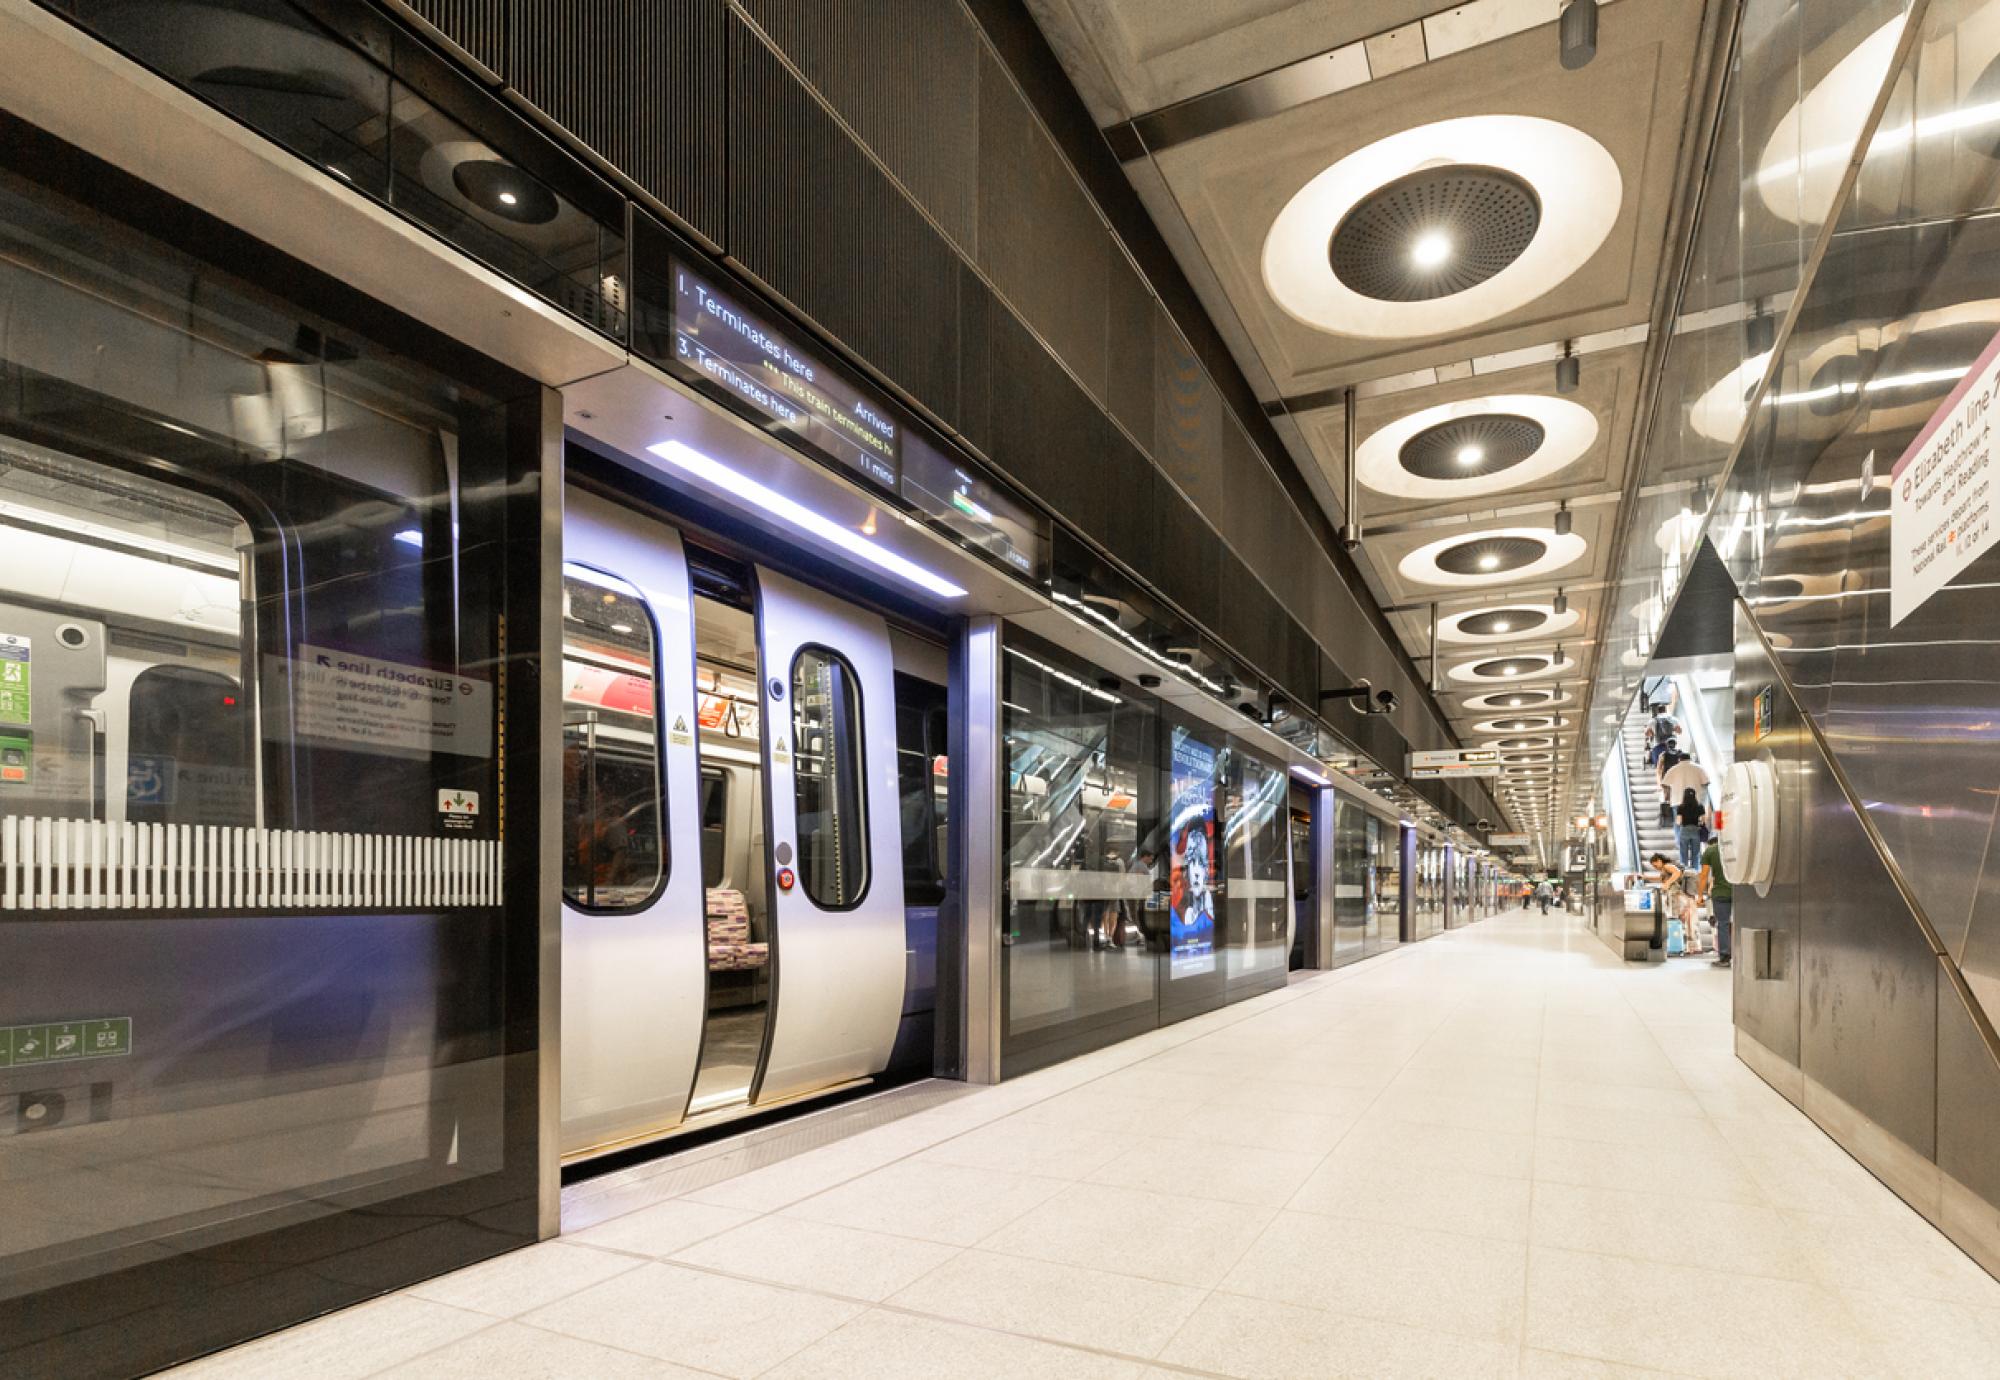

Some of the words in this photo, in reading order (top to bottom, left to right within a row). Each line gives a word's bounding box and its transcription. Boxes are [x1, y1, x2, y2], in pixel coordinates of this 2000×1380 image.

[695, 284, 781, 359] Terminates
[784, 348, 814, 382] here
[679, 337, 691, 357] 3.
[695, 347, 768, 405] Terminates
[770, 396, 796, 424] here
[782, 371, 804, 397] This
[806, 391, 831, 416] train
[832, 408, 882, 450] terminates
[855, 401, 893, 438] Arrived
[872, 463, 894, 484] mins
[1914, 419, 1963, 489] Elizabeth
[1967, 389, 1990, 429] line
[1915, 477, 1942, 513] Towards
[1943, 433, 1981, 481] Heathrow
[1942, 479, 1957, 505] and
[1958, 447, 1989, 488] Reading
